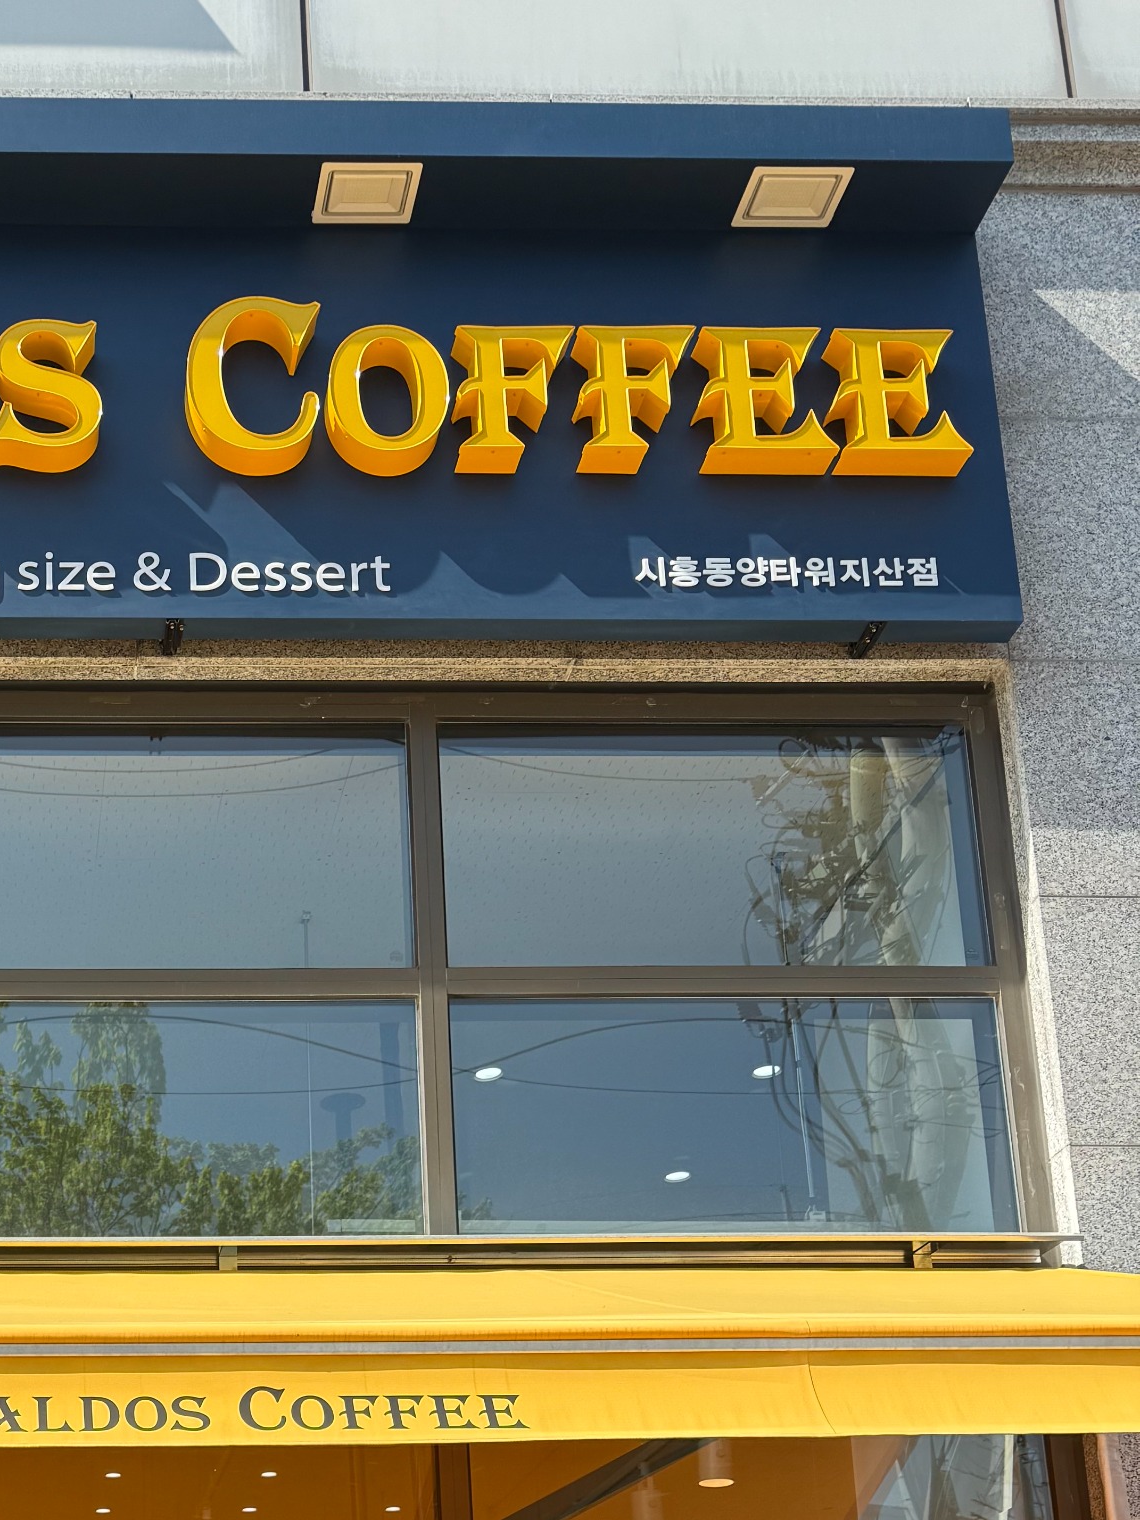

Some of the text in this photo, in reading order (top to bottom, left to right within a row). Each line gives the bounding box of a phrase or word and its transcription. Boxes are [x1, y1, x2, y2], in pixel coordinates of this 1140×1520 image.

[185, 295, 975, 477] COFFEE
[17, 551, 116, 592] size
[133, 551, 171, 592] &
[189, 551, 391, 592] Dessert
[635, 556, 939, 587] 시흥동양타워지산점
[238, 1386, 530, 1430] COFFEE
